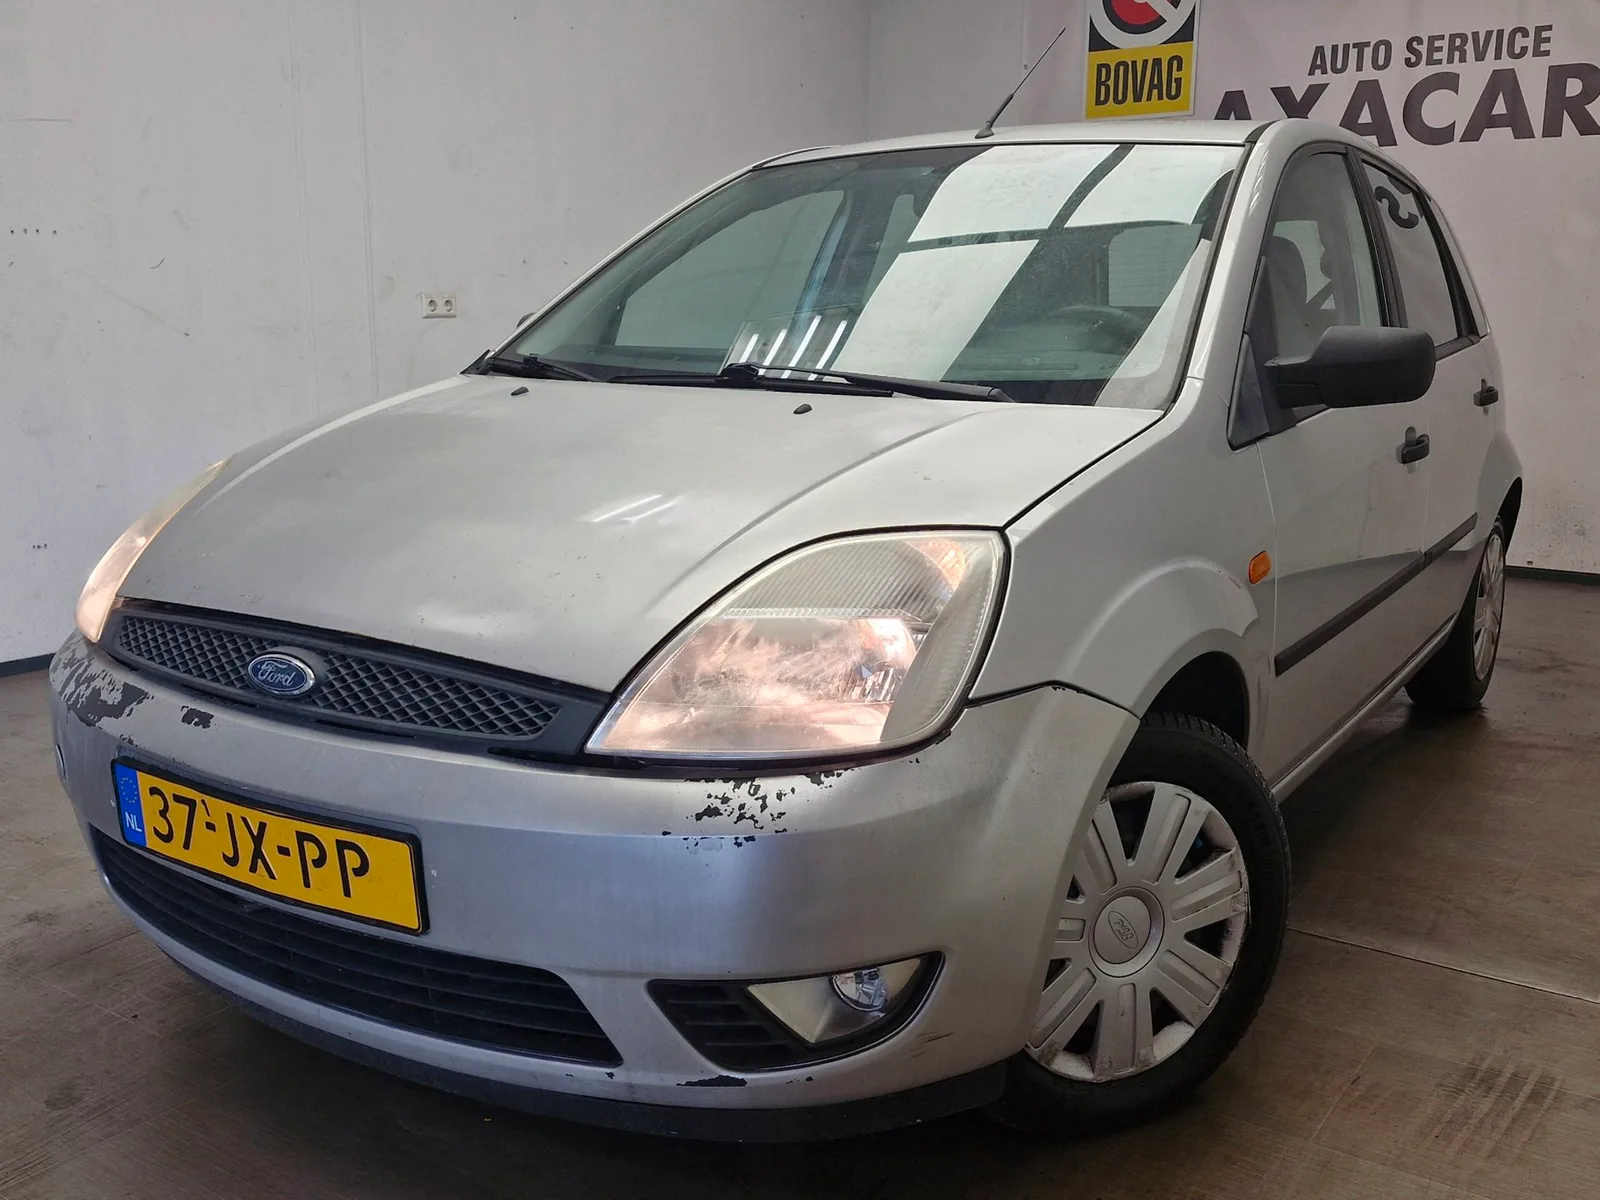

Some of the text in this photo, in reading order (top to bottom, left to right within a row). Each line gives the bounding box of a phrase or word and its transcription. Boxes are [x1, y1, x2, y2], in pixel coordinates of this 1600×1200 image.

[1308, 24, 1553, 76] AUTO SERVICE
[1095, 55, 1183, 107] BOVAG
[258, 661, 296, 686] Ford
[125, 812, 142, 832] NL
[148, 786, 370, 898] 37-JX-PP
